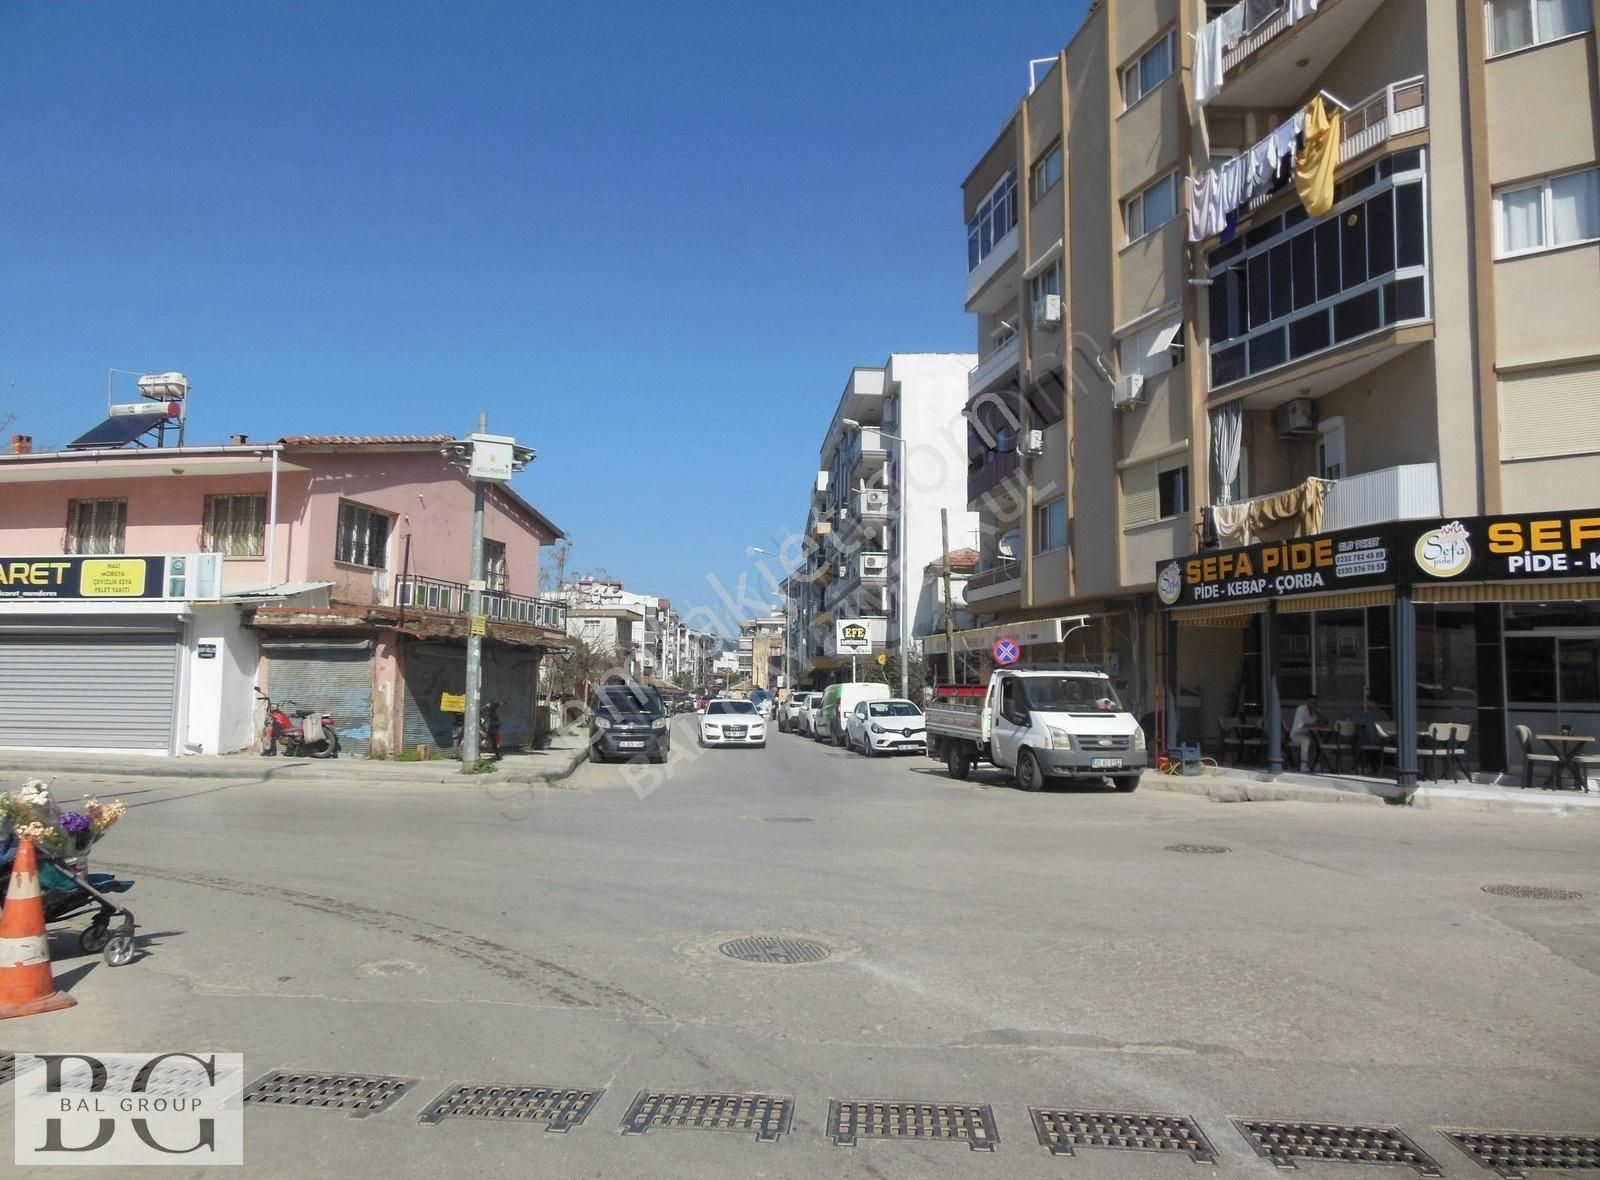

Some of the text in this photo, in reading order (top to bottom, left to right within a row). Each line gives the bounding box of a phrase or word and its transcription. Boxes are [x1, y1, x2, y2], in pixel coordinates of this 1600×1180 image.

[1186, 538, 1334, 584] SEFA PİDE
[1423, 535, 1466, 565] Sefa
[1508, 551, 1569, 573] PİDE
[1194, 583, 1219, 600] PİDE
[1228, 579, 1267, 597] KEBAP
[1275, 572, 1325, 595] ÇORBA
[845, 627, 865, 638] EFE
